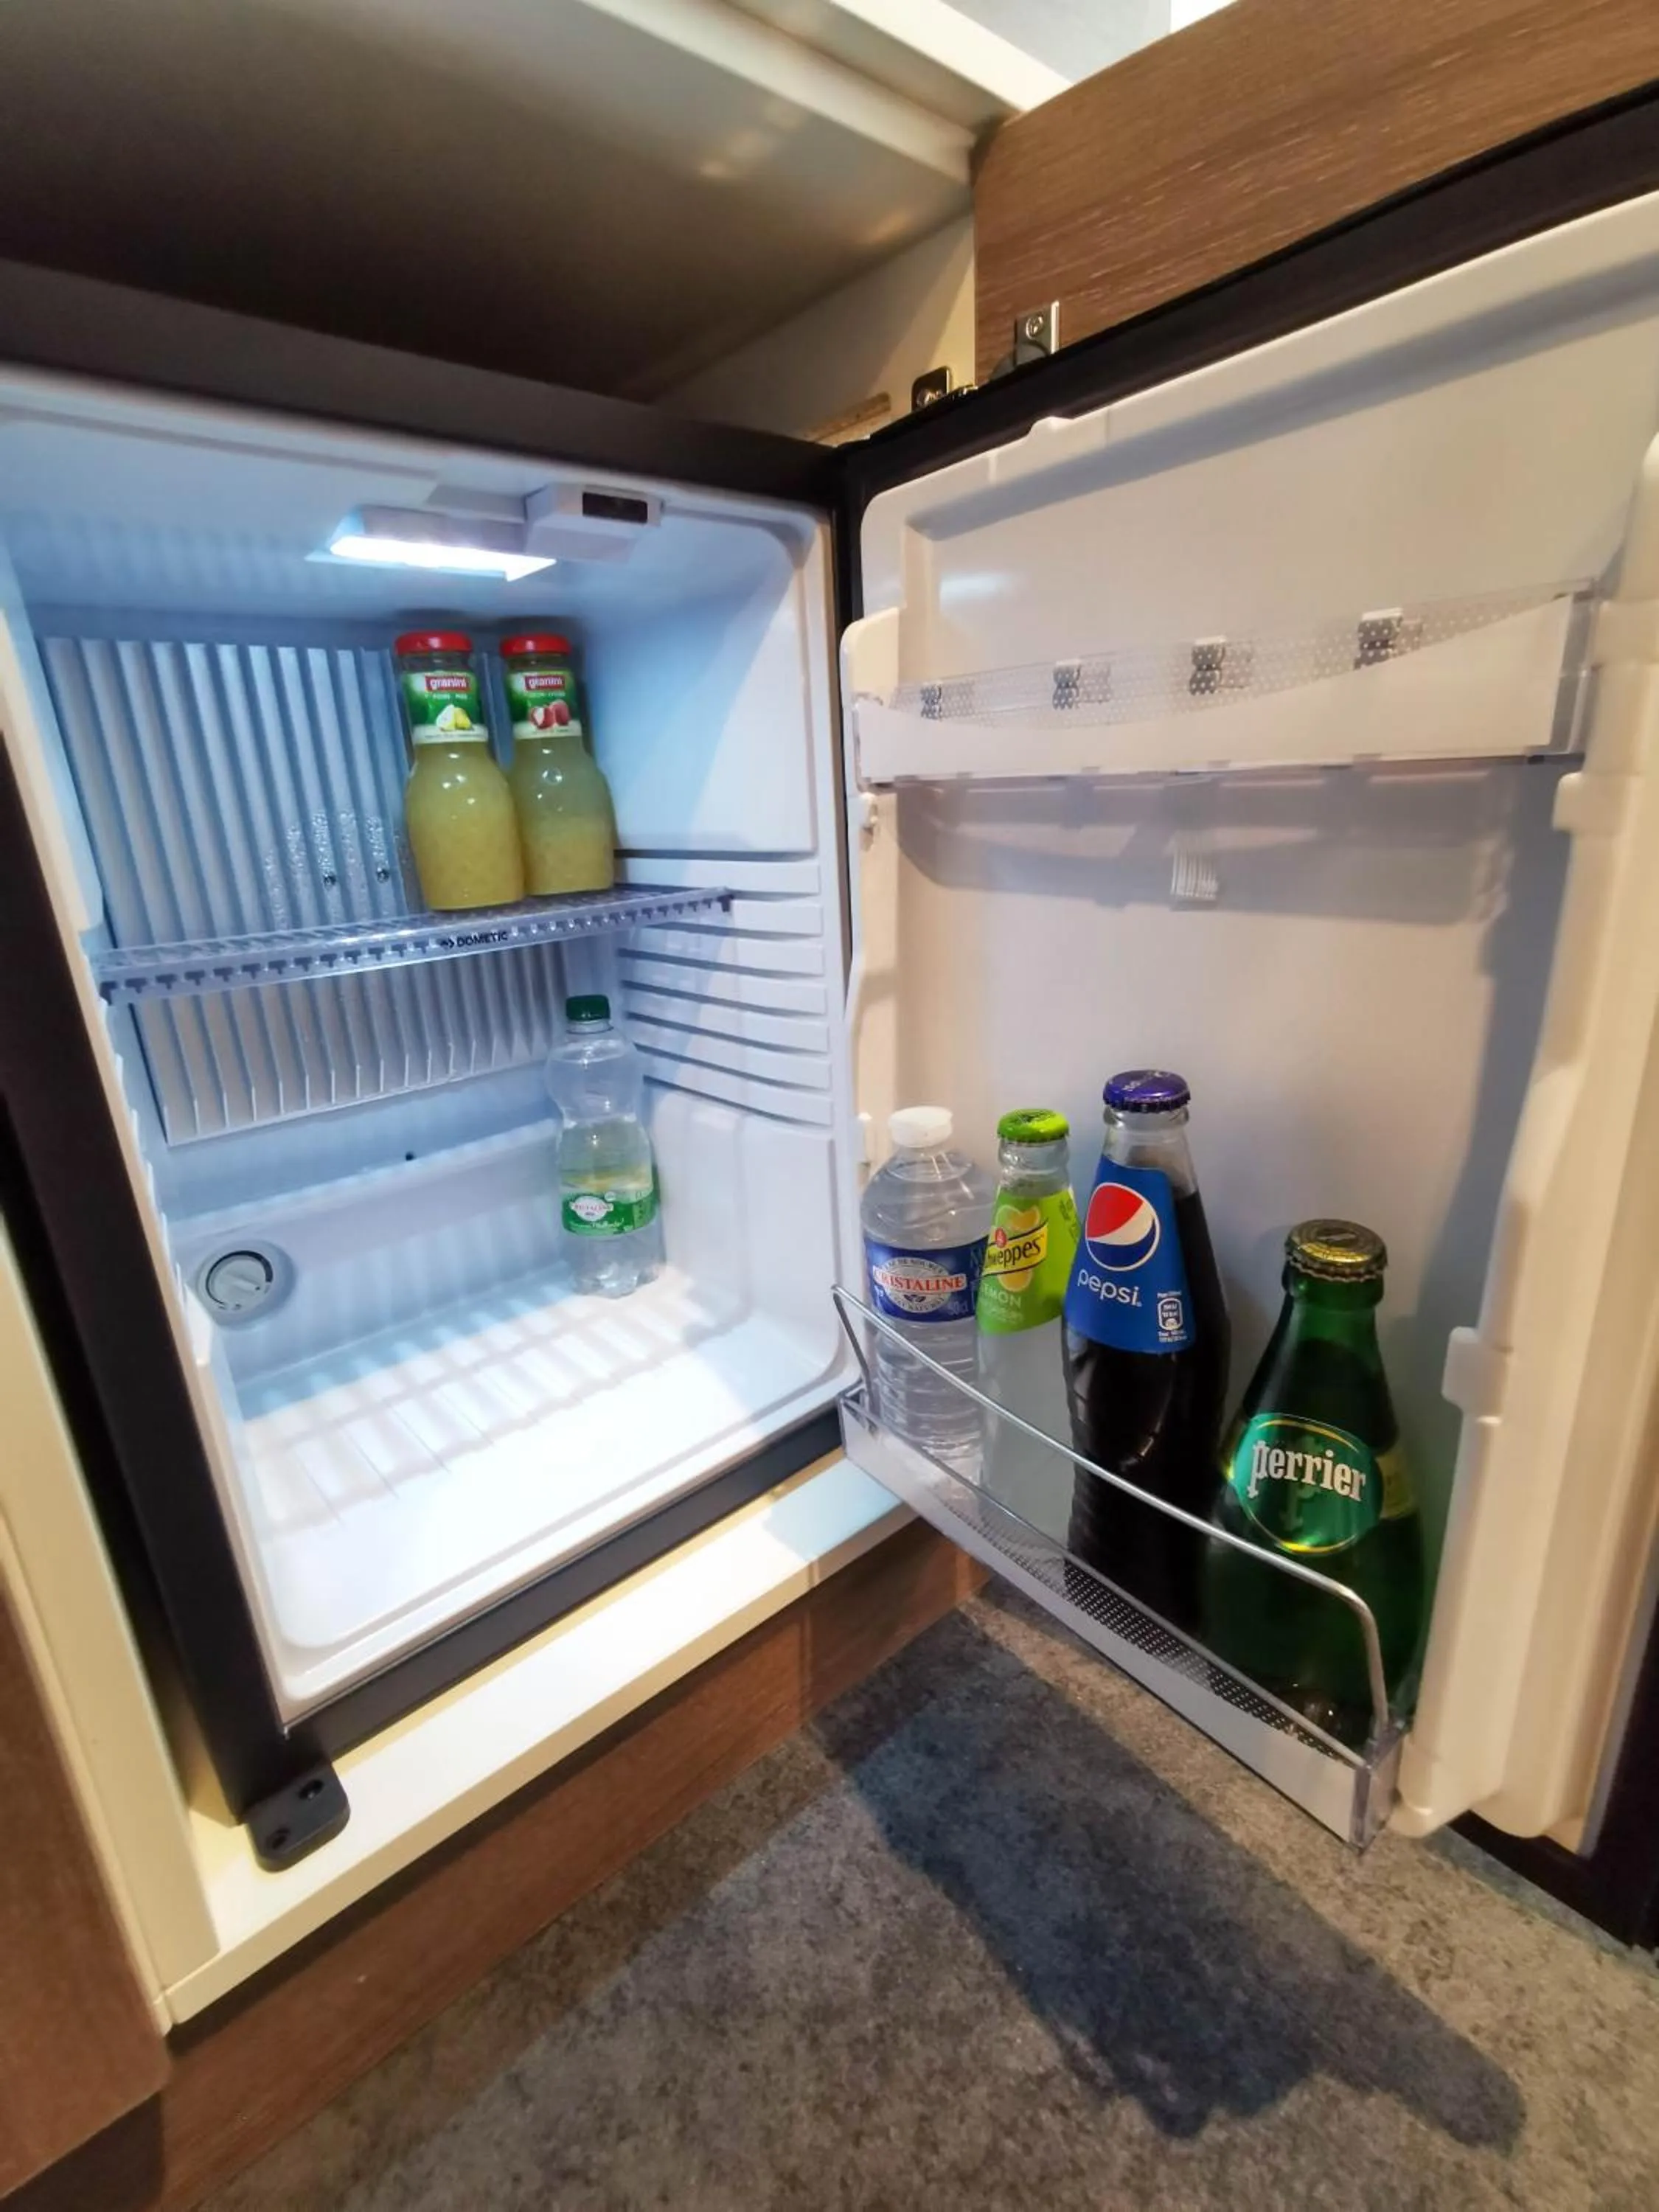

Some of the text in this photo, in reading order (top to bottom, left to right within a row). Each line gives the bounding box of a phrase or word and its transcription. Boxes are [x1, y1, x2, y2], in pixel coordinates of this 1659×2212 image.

[457, 931, 508, 947] DOMETIC
[988, 1237, 1041, 1268] eppes
[1077, 1268, 1138, 1306] pepsi
[1247, 1439, 1366, 1502] perrier
